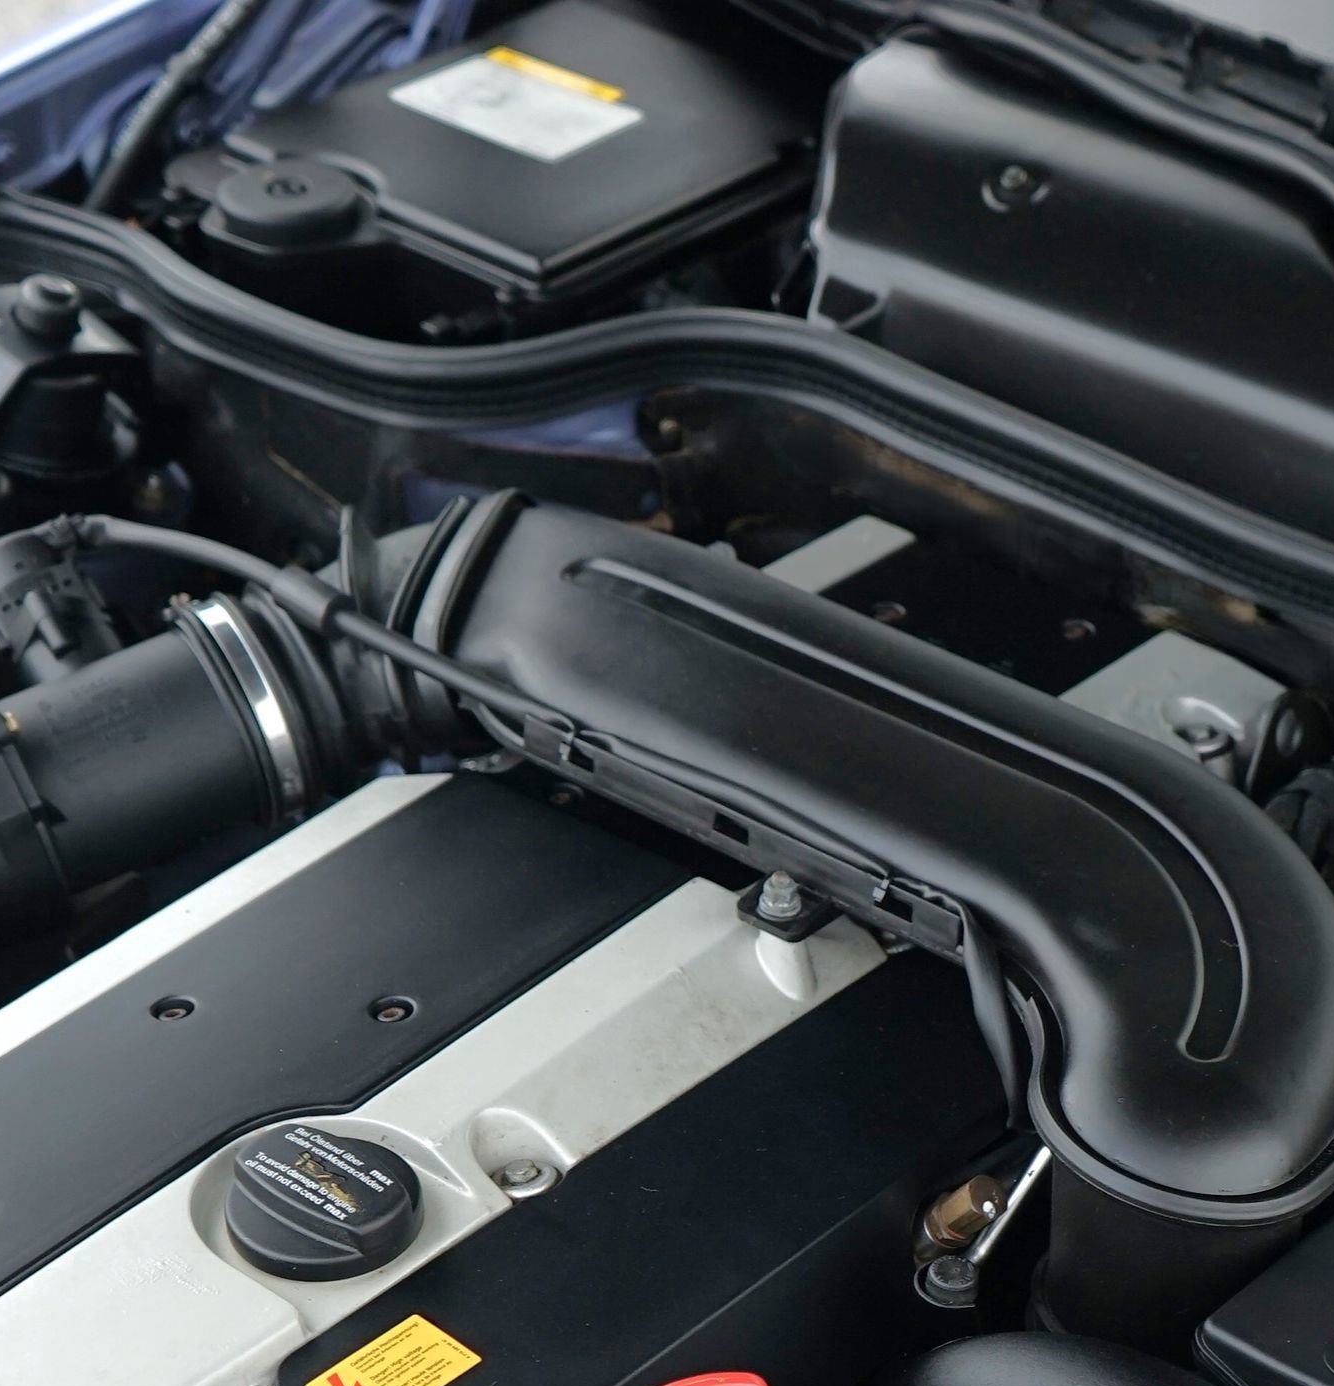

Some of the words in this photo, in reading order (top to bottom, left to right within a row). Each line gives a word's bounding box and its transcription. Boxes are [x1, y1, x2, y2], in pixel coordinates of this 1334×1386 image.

[284, 1133, 313, 1151] Gefahr
[310, 1143, 328, 1158] von
[294, 1127, 311, 1139] Bei
[310, 1131, 345, 1155] Ölstand
[342, 1150, 365, 1167] über
[368, 1169, 395, 1186] max
[244, 1159, 256, 1169] oil
[255, 1164, 276, 1178] must
[275, 1173, 291, 1185] not
[289, 1182, 324, 1205] exceed
[322, 1203, 349, 1220] max
[254, 1152, 266, 1161] To
[264, 1157, 290, 1173] avoid
[287, 1166, 319, 1190] damage
[317, 1186, 329, 1195] to
[327, 1193, 357, 1214] engine
